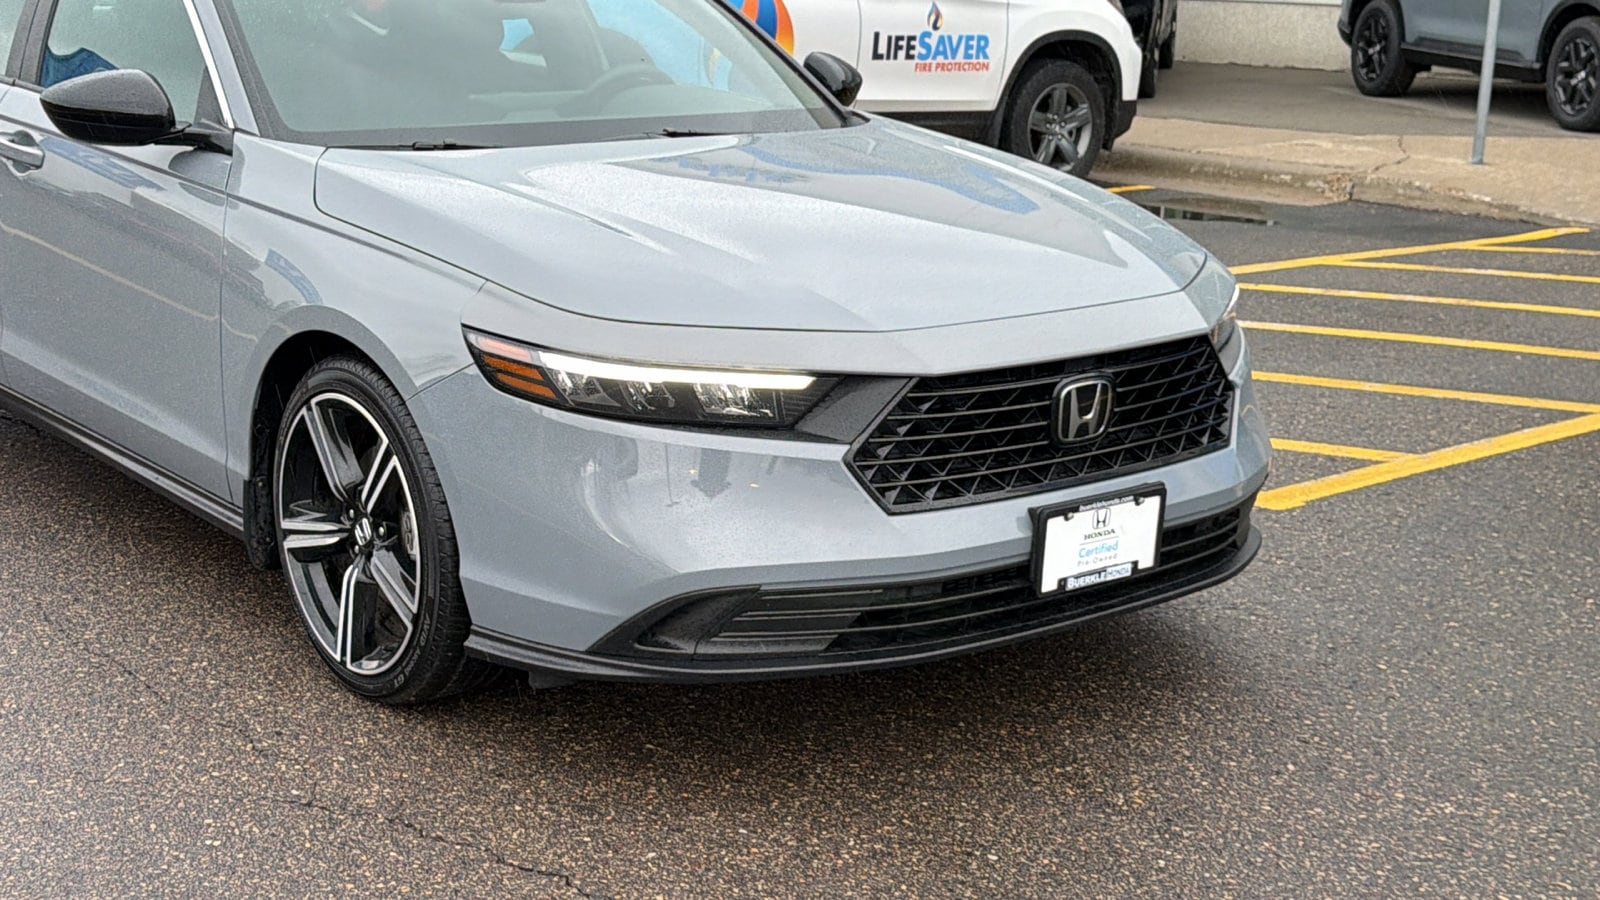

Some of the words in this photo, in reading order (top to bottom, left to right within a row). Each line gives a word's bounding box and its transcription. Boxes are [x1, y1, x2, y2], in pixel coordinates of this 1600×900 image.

[871, 30, 990, 61] LIFESAVER
[914, 62, 932, 72] FIRE
[935, 62, 989, 72] PROTECTION
[1083, 528, 1116, 541] HONDA
[1078, 540, 1119, 558] Certified
